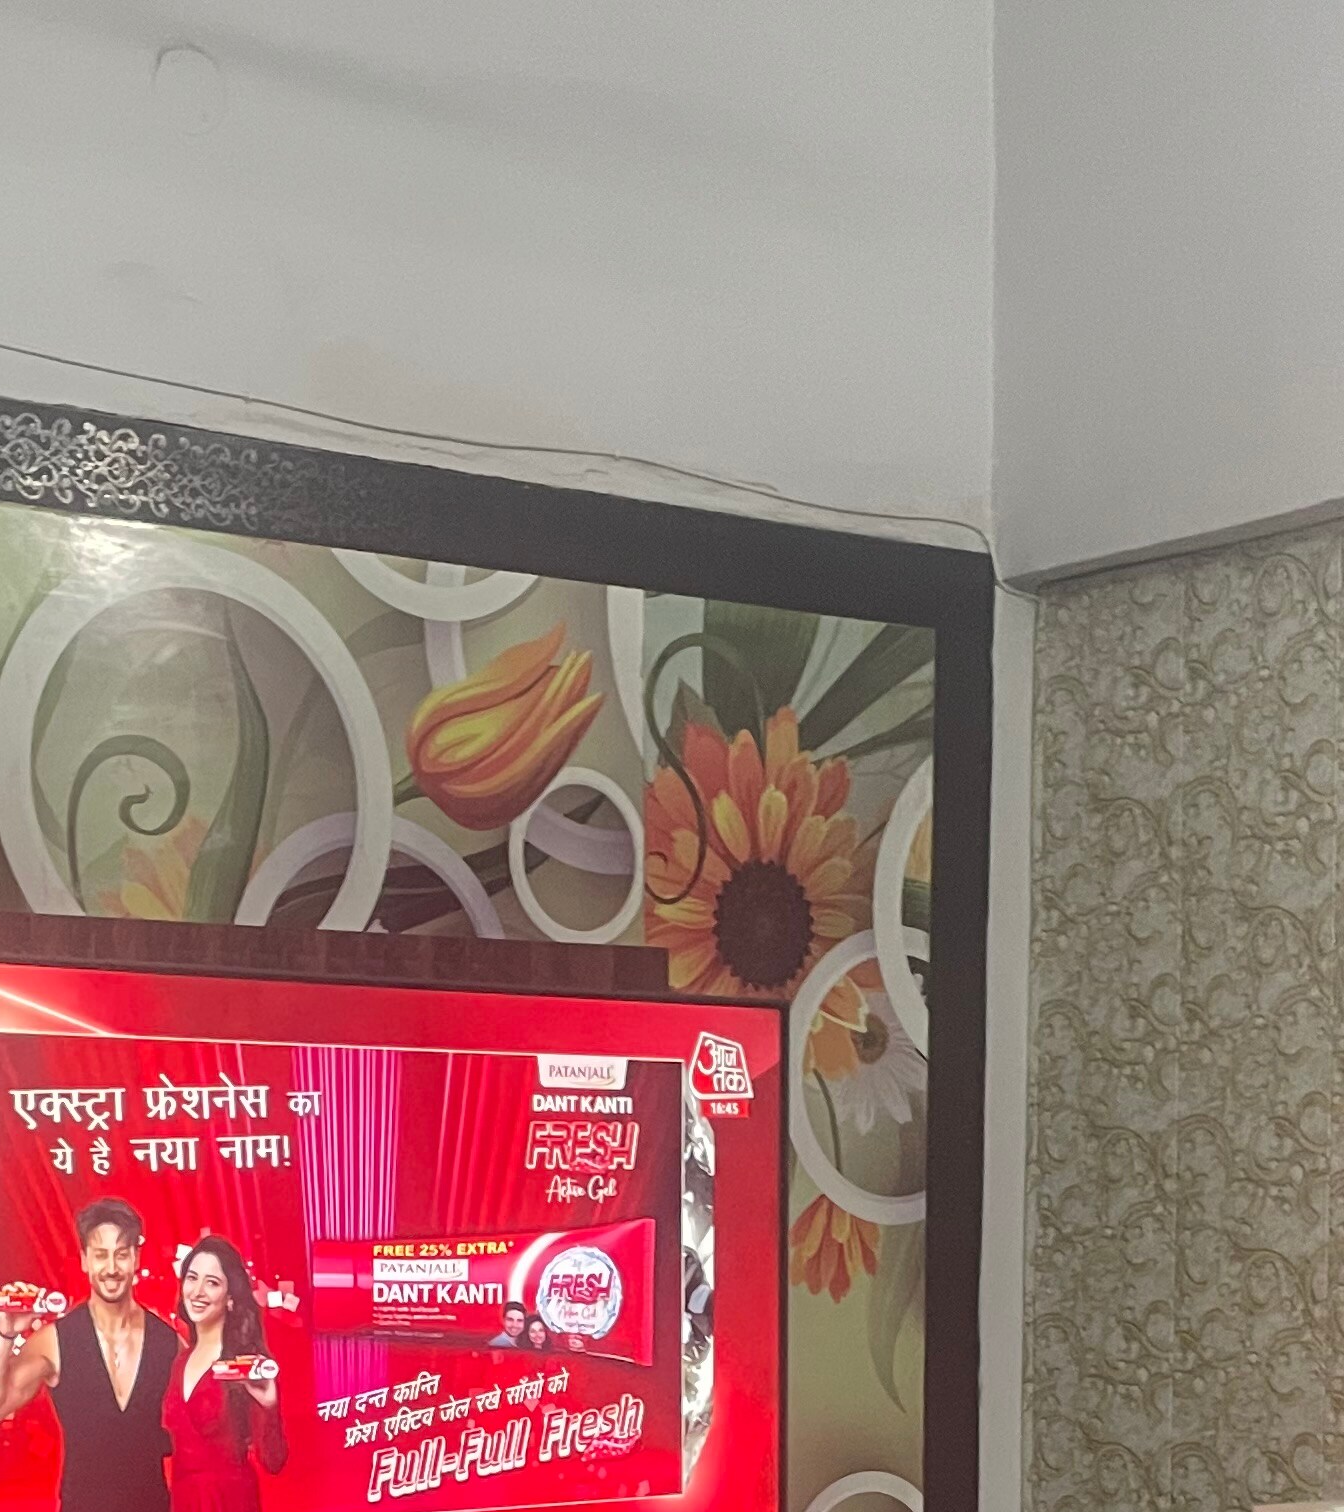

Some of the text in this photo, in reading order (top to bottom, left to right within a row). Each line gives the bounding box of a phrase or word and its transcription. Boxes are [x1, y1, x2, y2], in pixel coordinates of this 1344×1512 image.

[698, 1038, 738, 1074] आज
[548, 1064, 613, 1082] PATANJALI
[713, 1066, 747, 1094] तक
[142, 1073, 270, 1120] फ्रेशनेस
[287, 1090, 322, 1118] का
[533, 1094, 633, 1115] DANT KANTI
[50, 1135, 292, 1175] ये है नया नाम!
[525, 1120, 640, 1171] FRESH
[373, 1243, 414, 1257] FREE
[419, 1243, 452, 1257] 25%
[379, 1261, 463, 1278] PATANJALI
[373, 1282, 503, 1305] DANT KANTI
[547, 1273, 613, 1304] FRESH
[317, 1397, 350, 1422] नया
[354, 1391, 387, 1413] दन्त
[343, 1417, 378, 1448] फ्रेश
[439, 1395, 469, 1426] जेल
[475, 1384, 501, 1413] रखे
[546, 1367, 570, 1395] को
[367, 1393, 645, 1503] Full-Full Fresh
